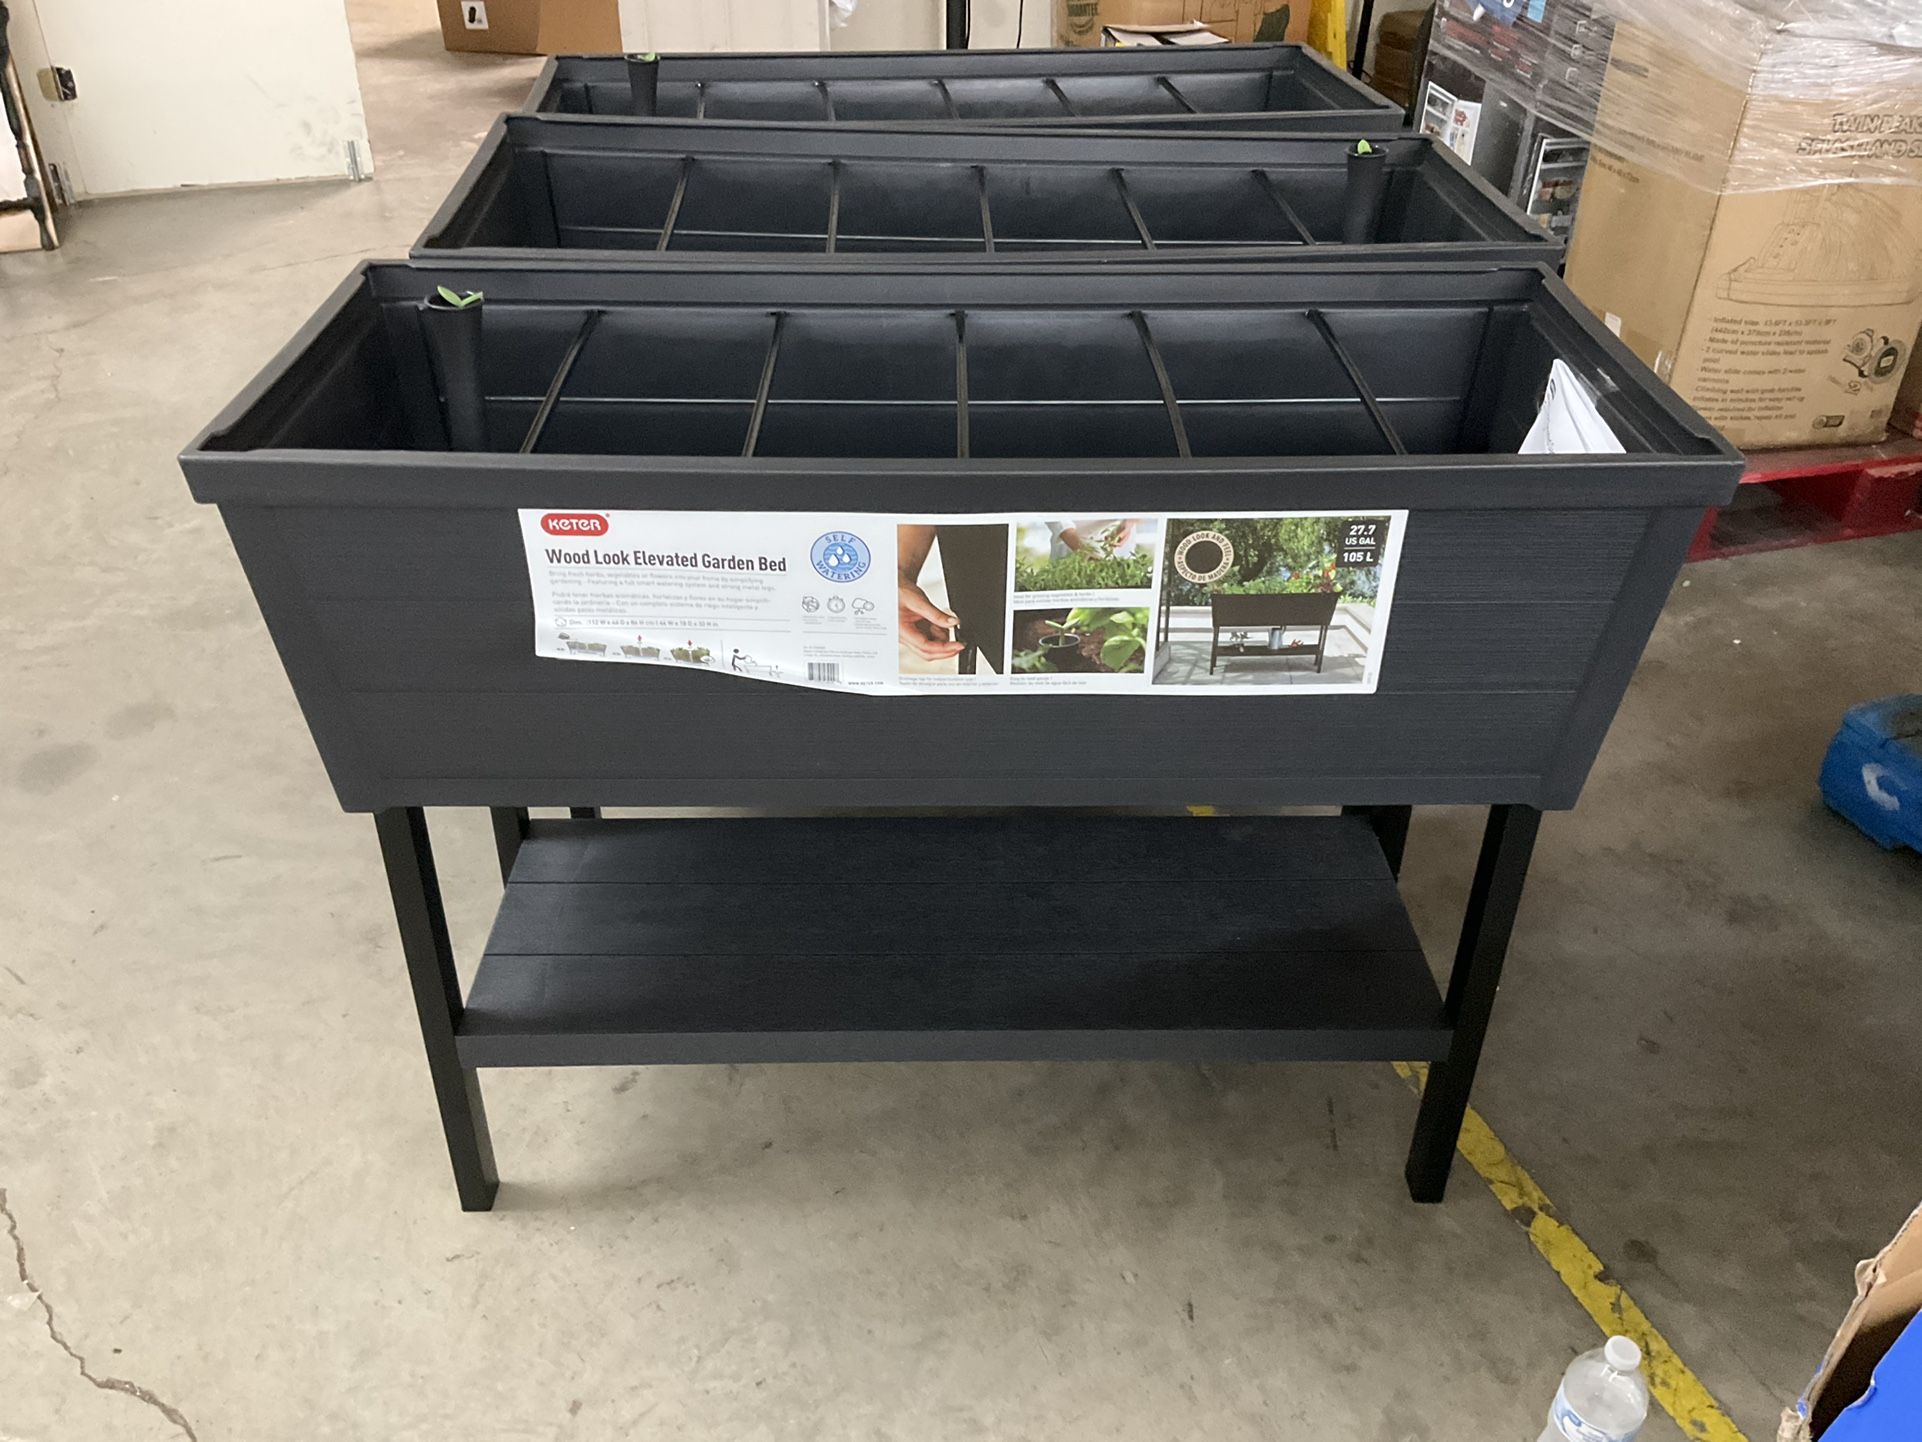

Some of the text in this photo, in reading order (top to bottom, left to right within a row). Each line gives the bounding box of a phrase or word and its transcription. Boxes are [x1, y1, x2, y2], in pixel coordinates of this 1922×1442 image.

[1350, 525, 1376, 535] 27.7
[825, 534, 856, 544] SELF
[1177, 539, 1191, 555] WOOD
[1192, 533, 1209, 541] LOOK
[1211, 534, 1224, 543] AND
[1345, 537, 1376, 545] US GAL
[545, 549, 786, 572] Wood Look Elevated Garden Bed
[1343, 552, 1373, 562] 105 L
[815, 560, 867, 580] WATERING
